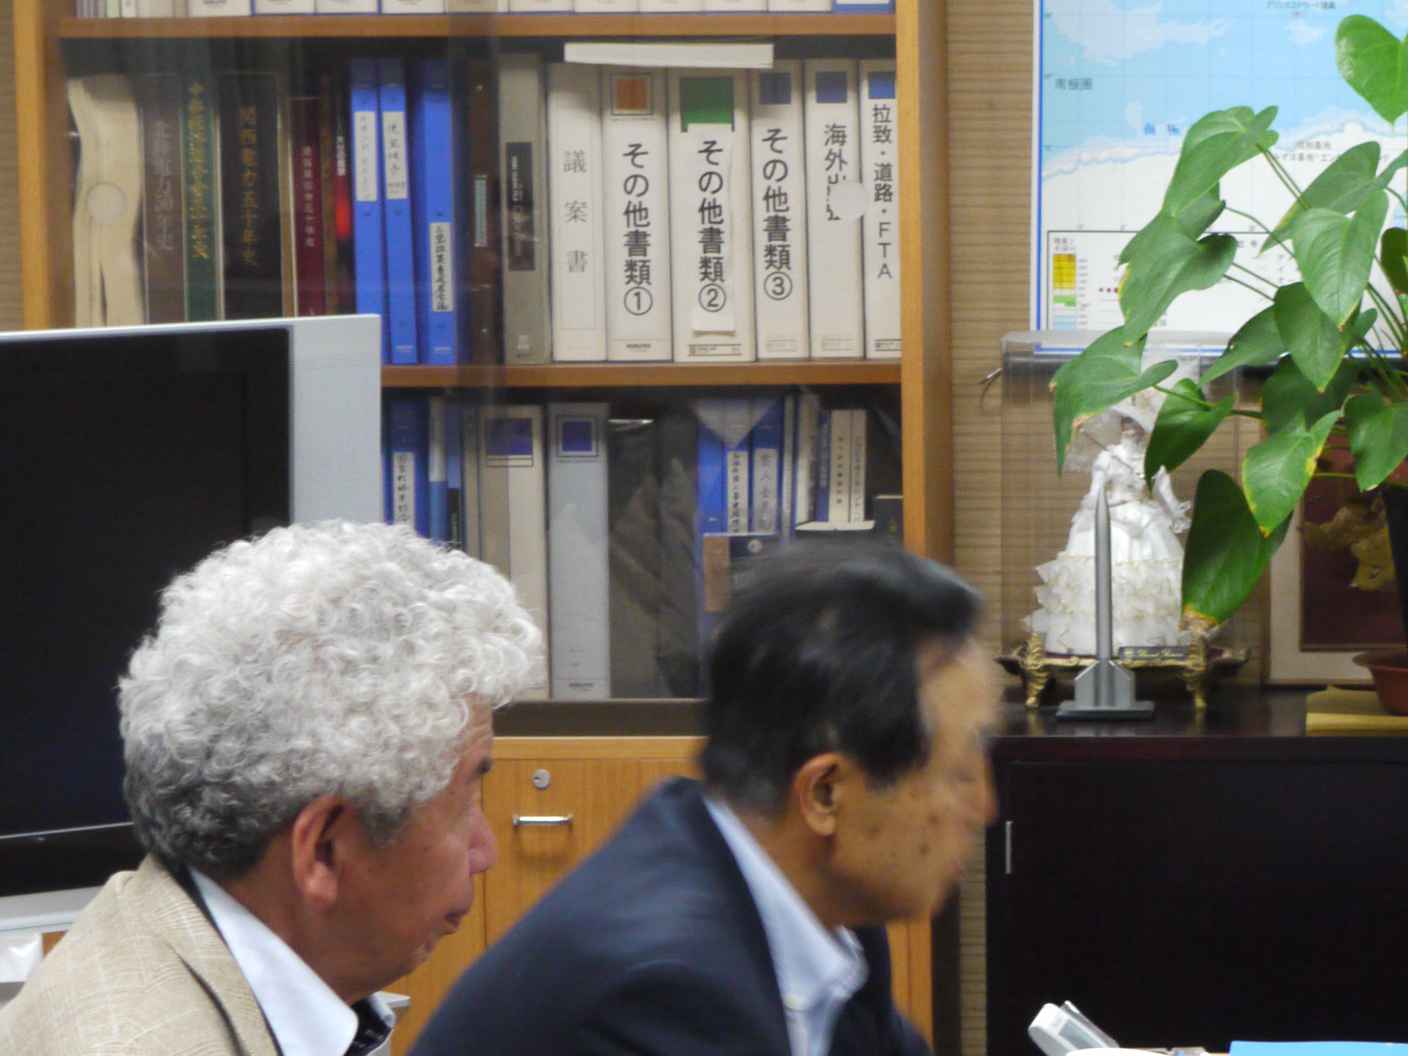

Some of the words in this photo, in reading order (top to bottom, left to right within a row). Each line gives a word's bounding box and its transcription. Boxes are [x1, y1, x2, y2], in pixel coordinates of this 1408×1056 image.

[562, 149, 589, 273] 議案書
[622, 142, 654, 316] その他書類①
[697, 139, 727, 313] その他書類②
[761, 127, 793, 301] その他書類③
